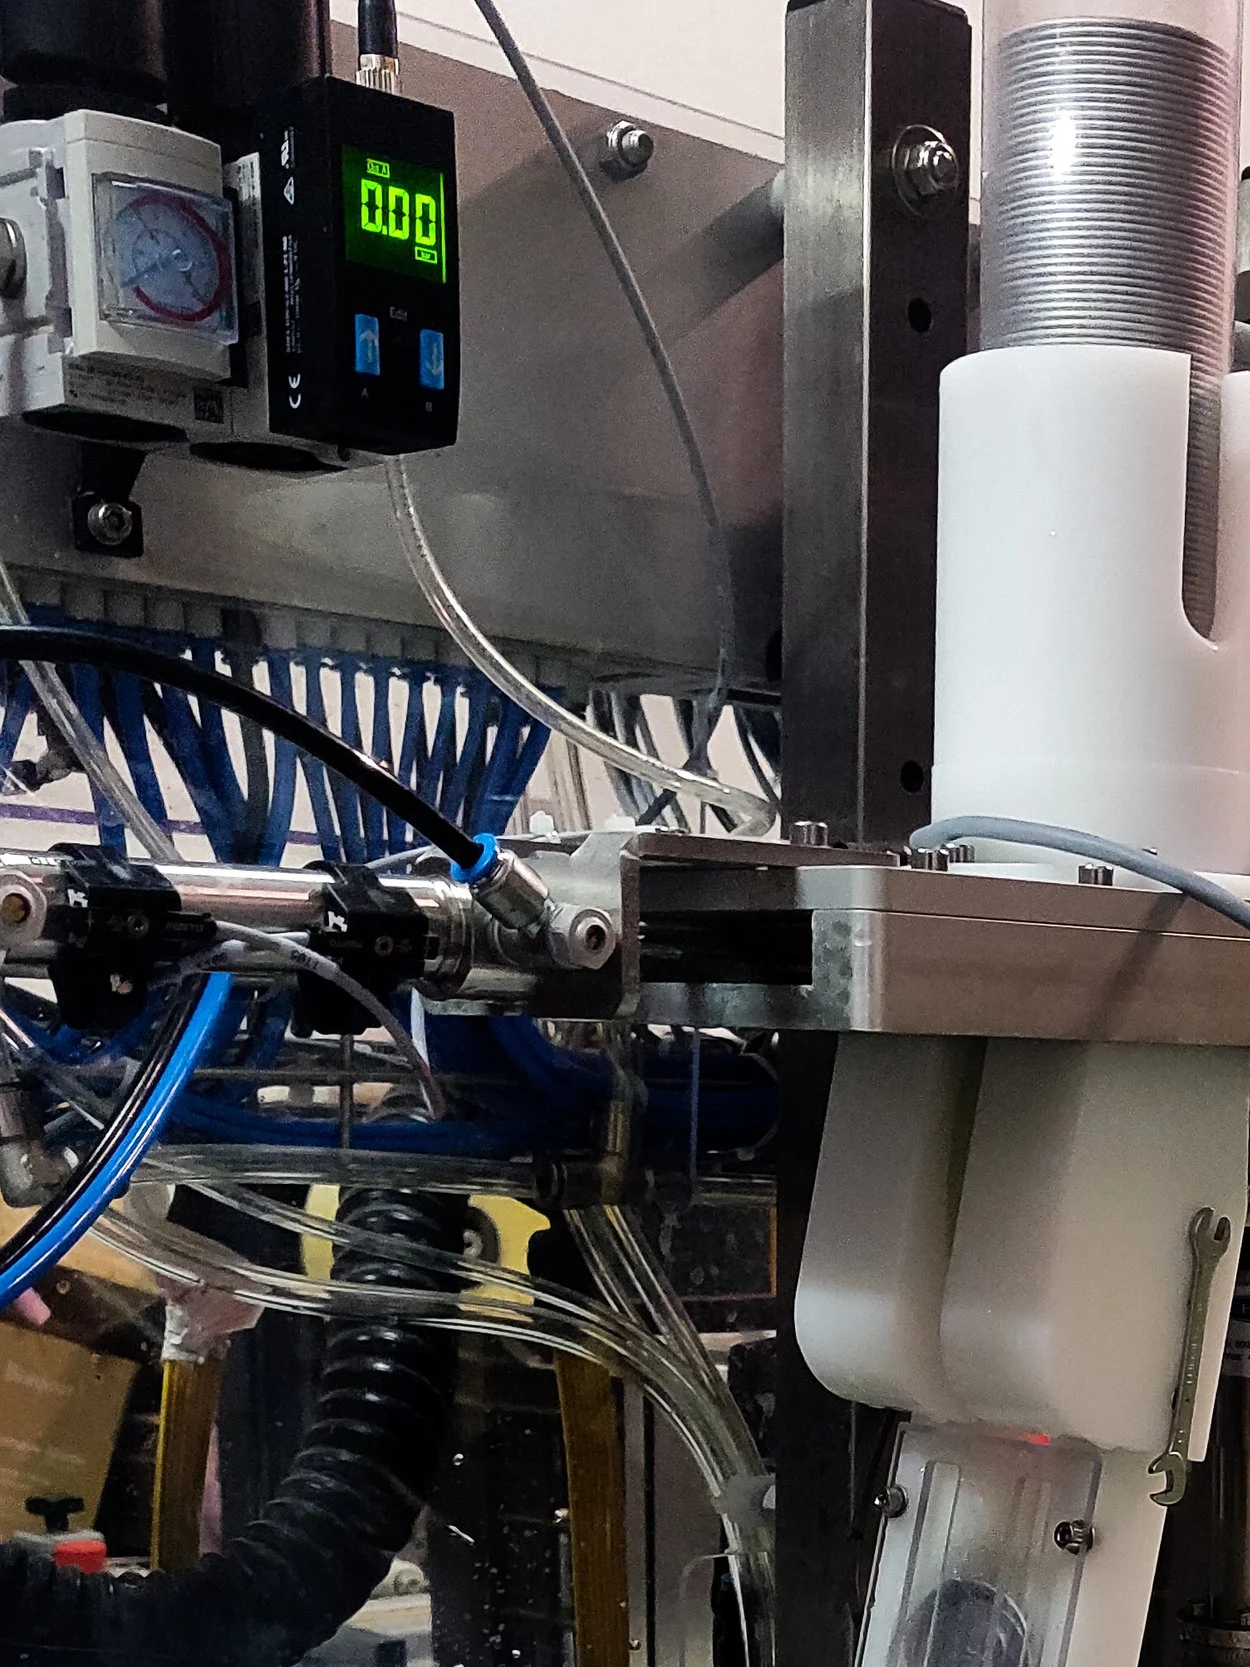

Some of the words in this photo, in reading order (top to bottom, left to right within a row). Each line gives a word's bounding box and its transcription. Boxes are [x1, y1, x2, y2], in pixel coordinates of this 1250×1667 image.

[361, 178, 437, 246] 0.00
[389, 306, 408, 322] Edit
[361, 388, 369, 399] A
